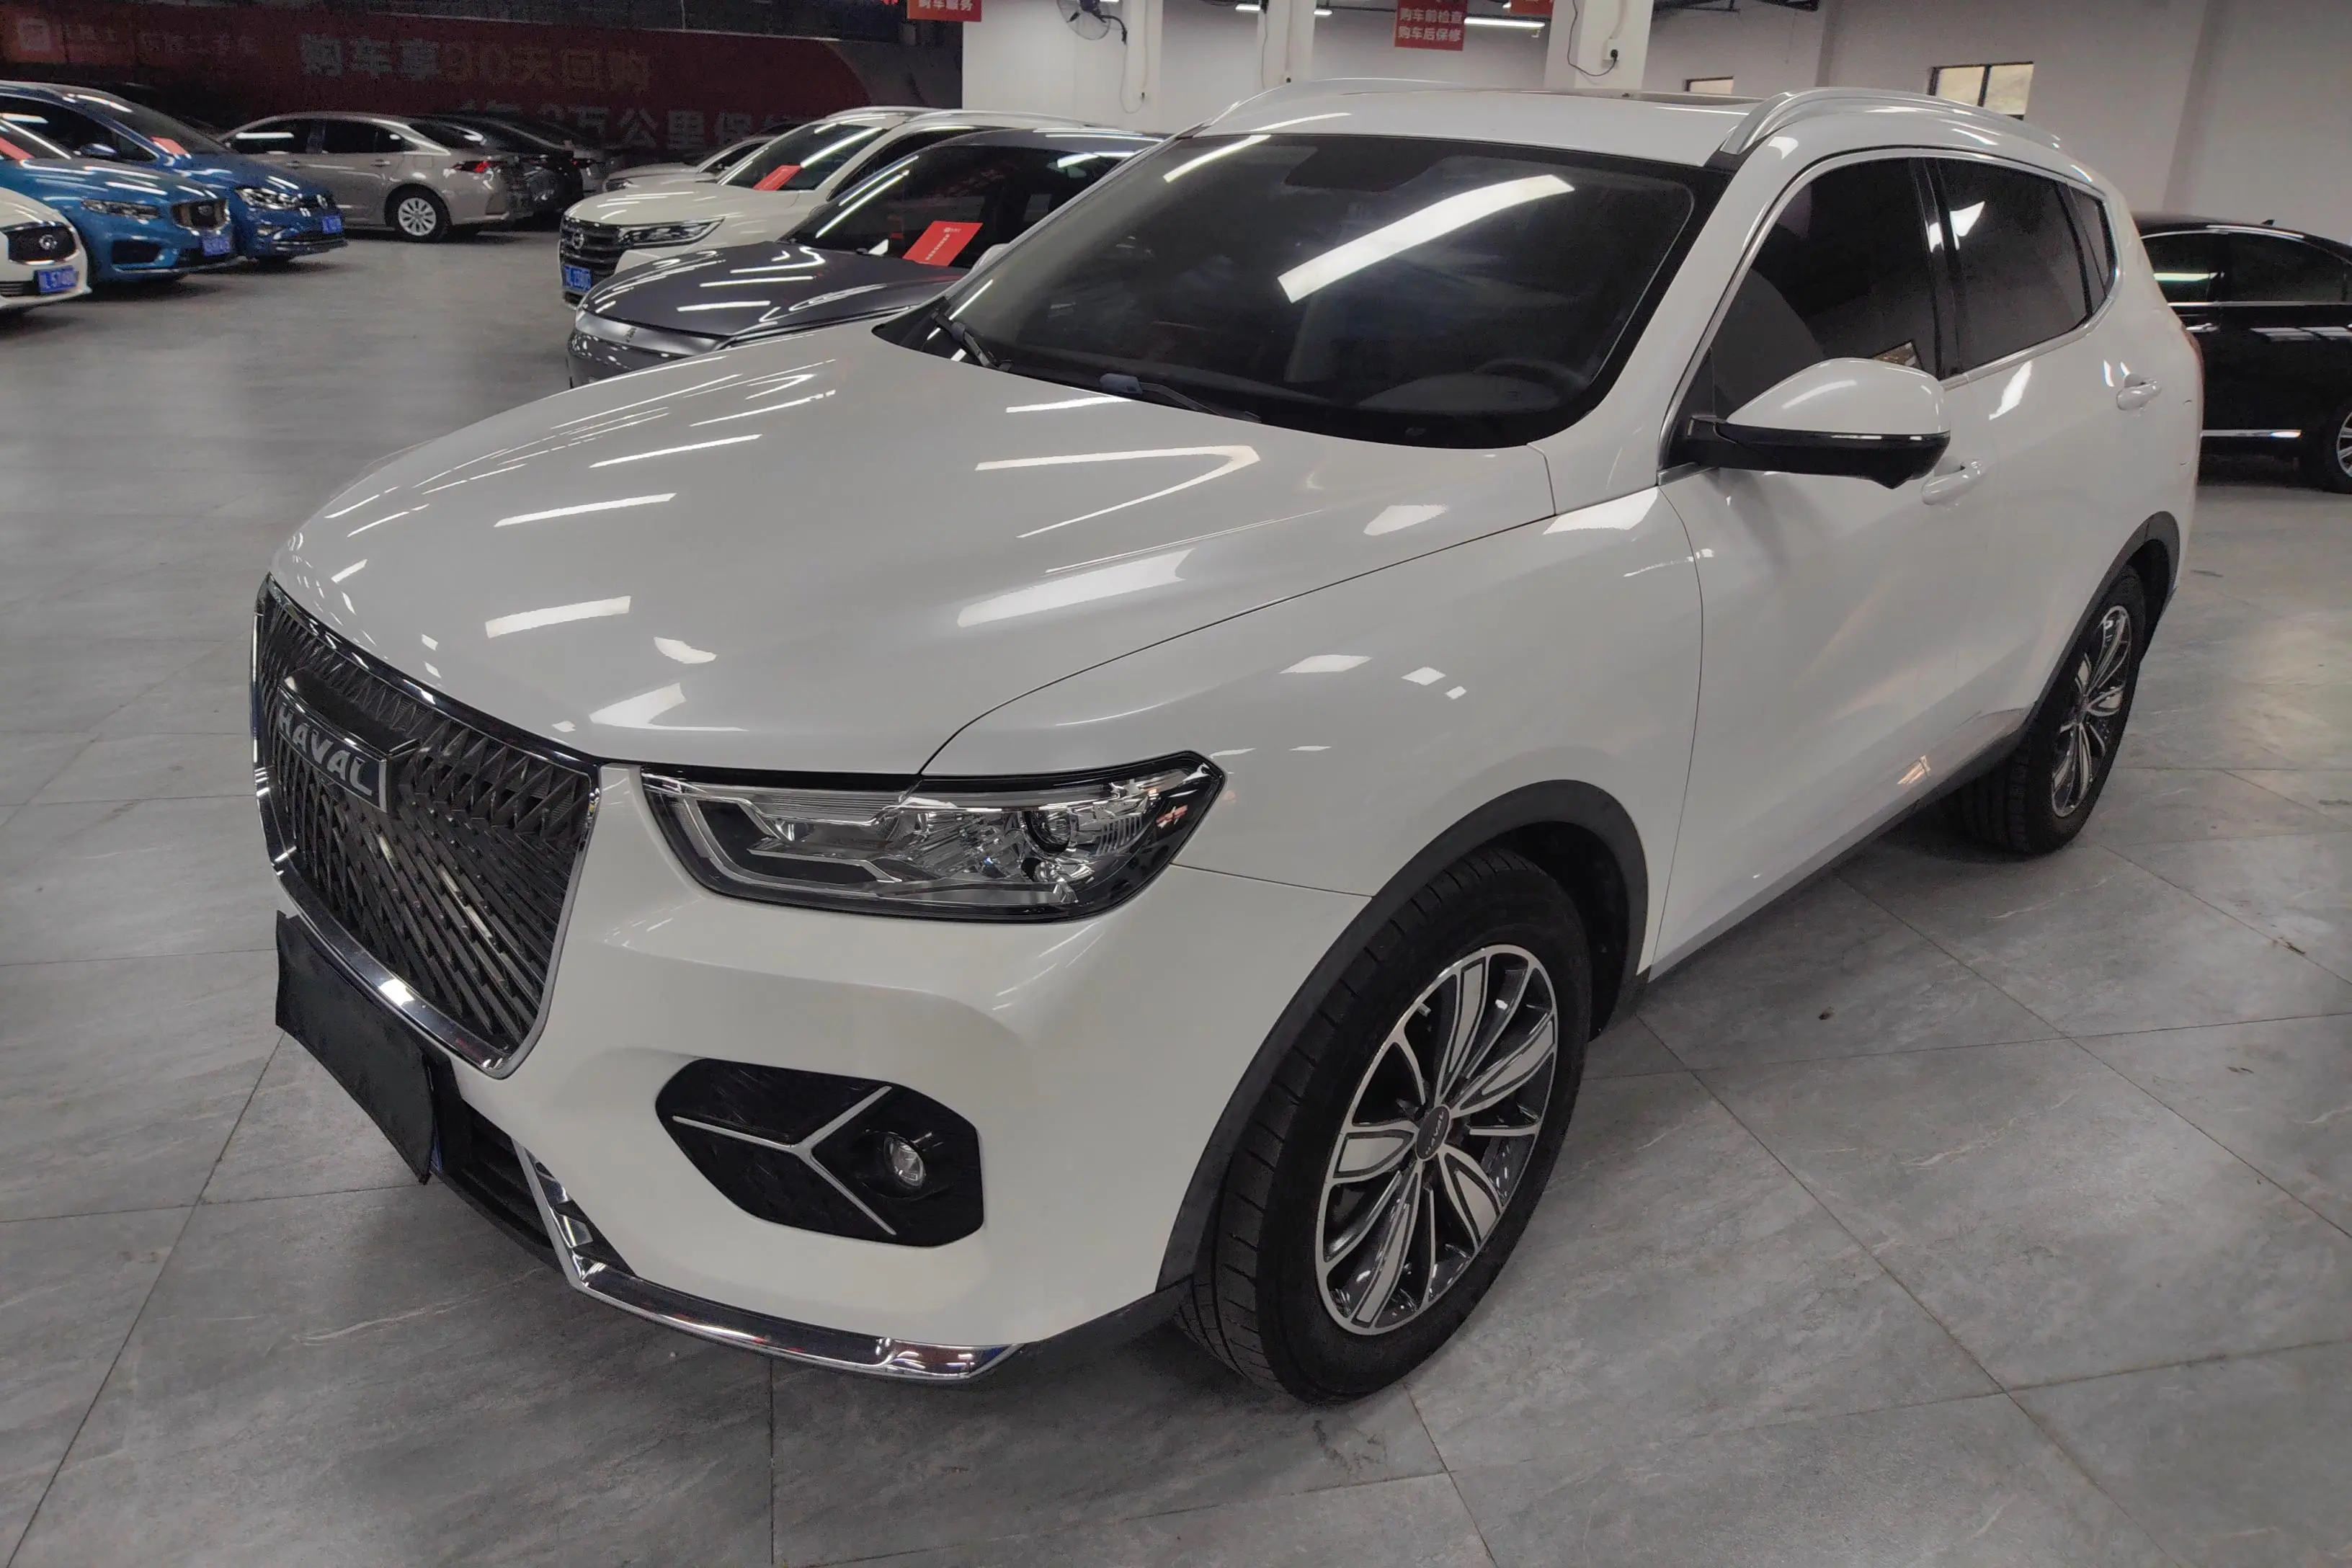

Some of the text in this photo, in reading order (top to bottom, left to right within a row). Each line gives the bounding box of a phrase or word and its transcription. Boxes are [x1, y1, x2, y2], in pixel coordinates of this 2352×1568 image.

[1399, 7, 1463, 24] 购车前检查
[1398, 26, 1461, 42] 购车后保修
[278, 702, 373, 796] HAVAL
